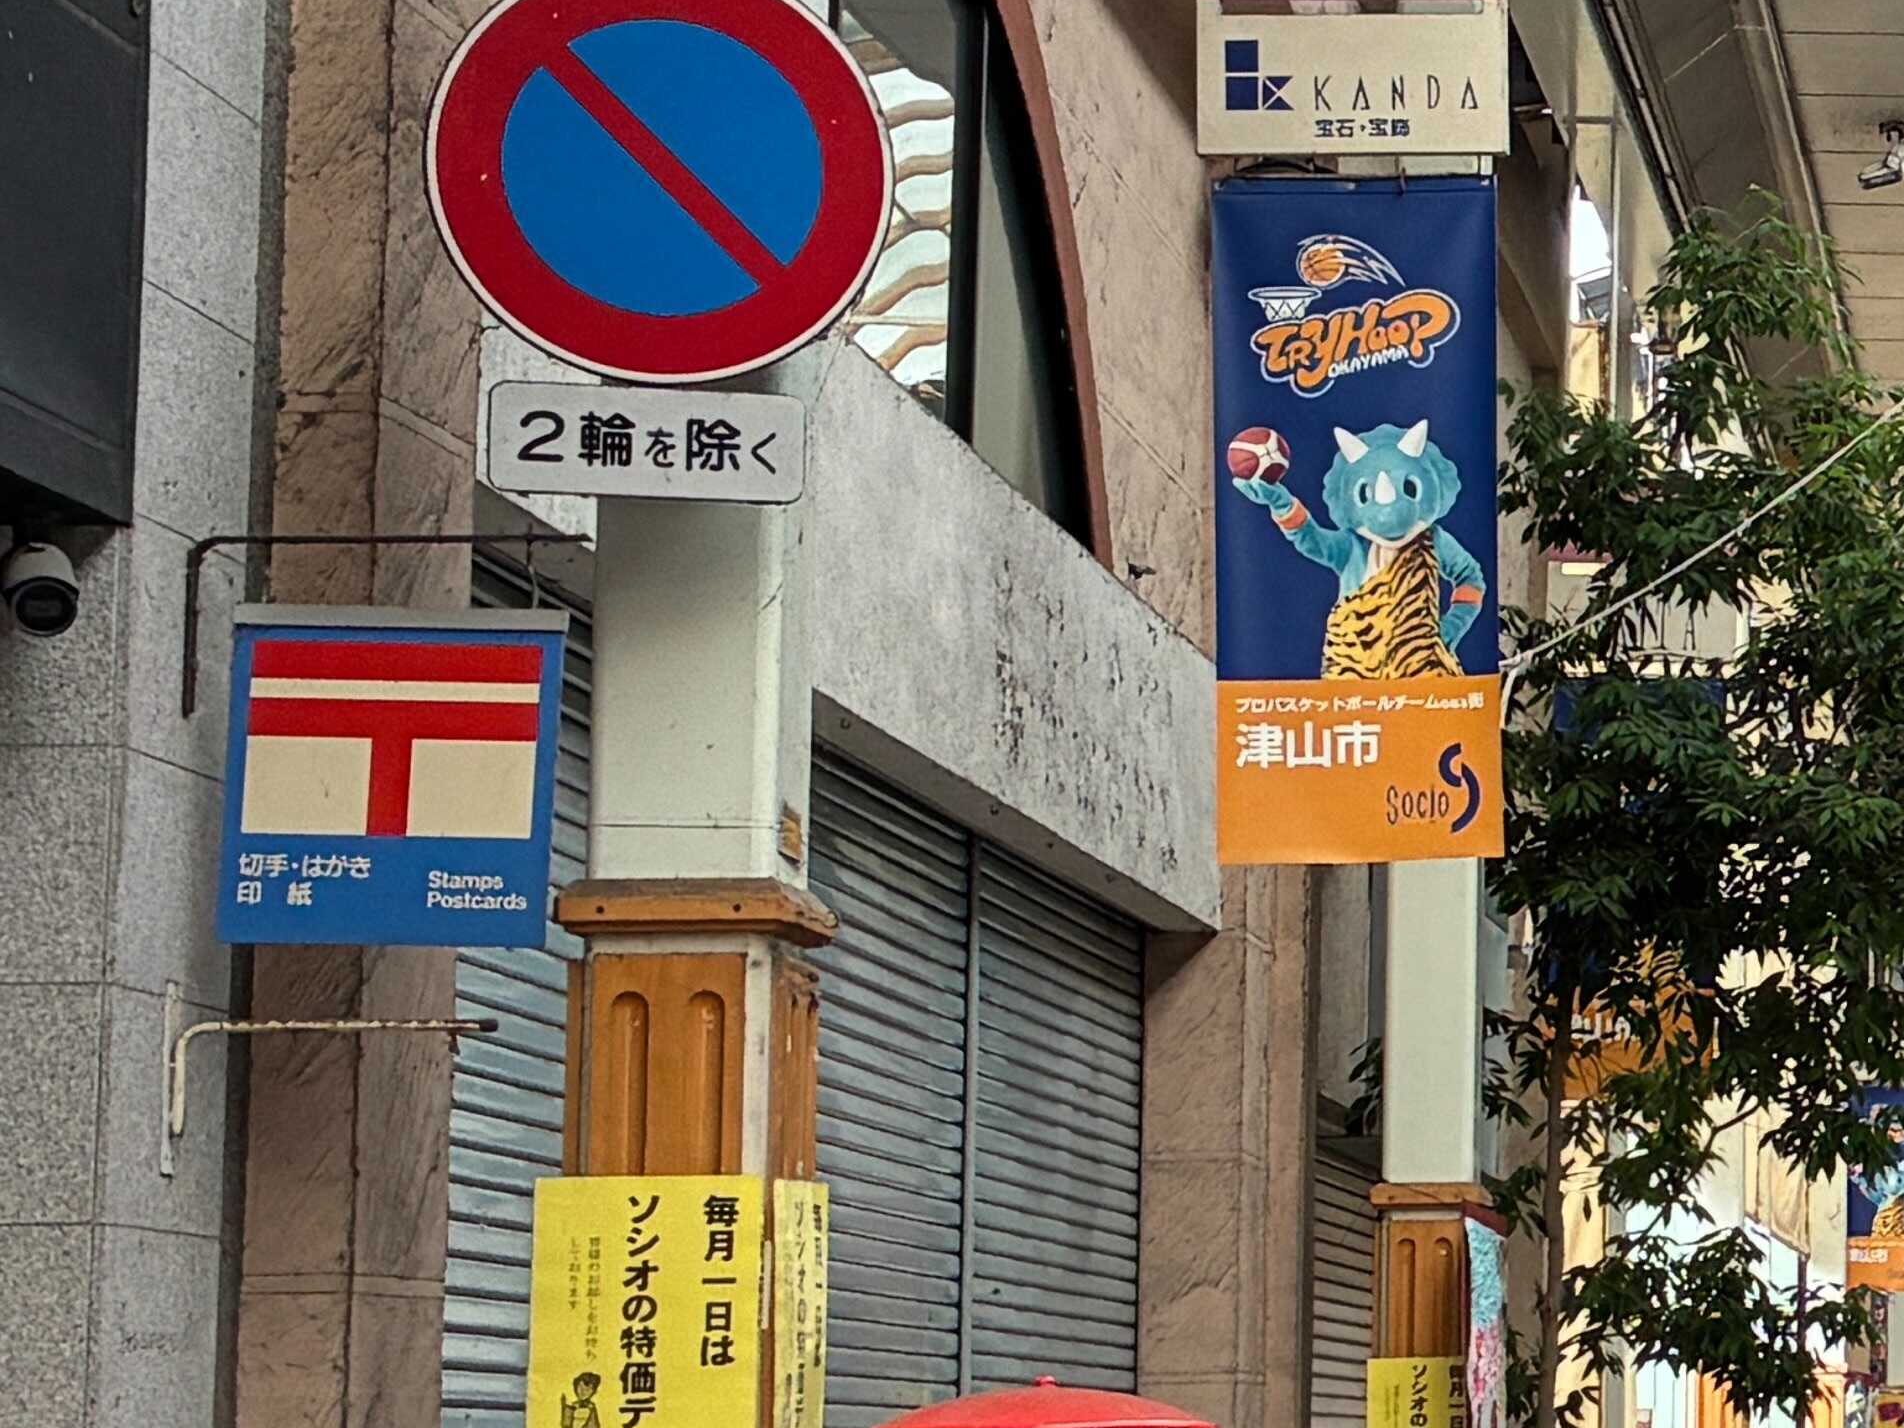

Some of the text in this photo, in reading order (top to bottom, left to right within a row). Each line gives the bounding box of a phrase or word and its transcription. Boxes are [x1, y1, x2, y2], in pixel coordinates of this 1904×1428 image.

[1313, 74, 1479, 111] KANDA
[1328, 345, 1409, 378] OKAYAMA
[515, 408, 778, 477] 2輪を除く
[1235, 720, 1381, 769] 津山市
[1386, 785, 1449, 824] Socio
[428, 871, 504, 891] Stamps
[427, 892, 527, 911] Postcards
[700, 1194, 740, 1367] 毎月一日は
